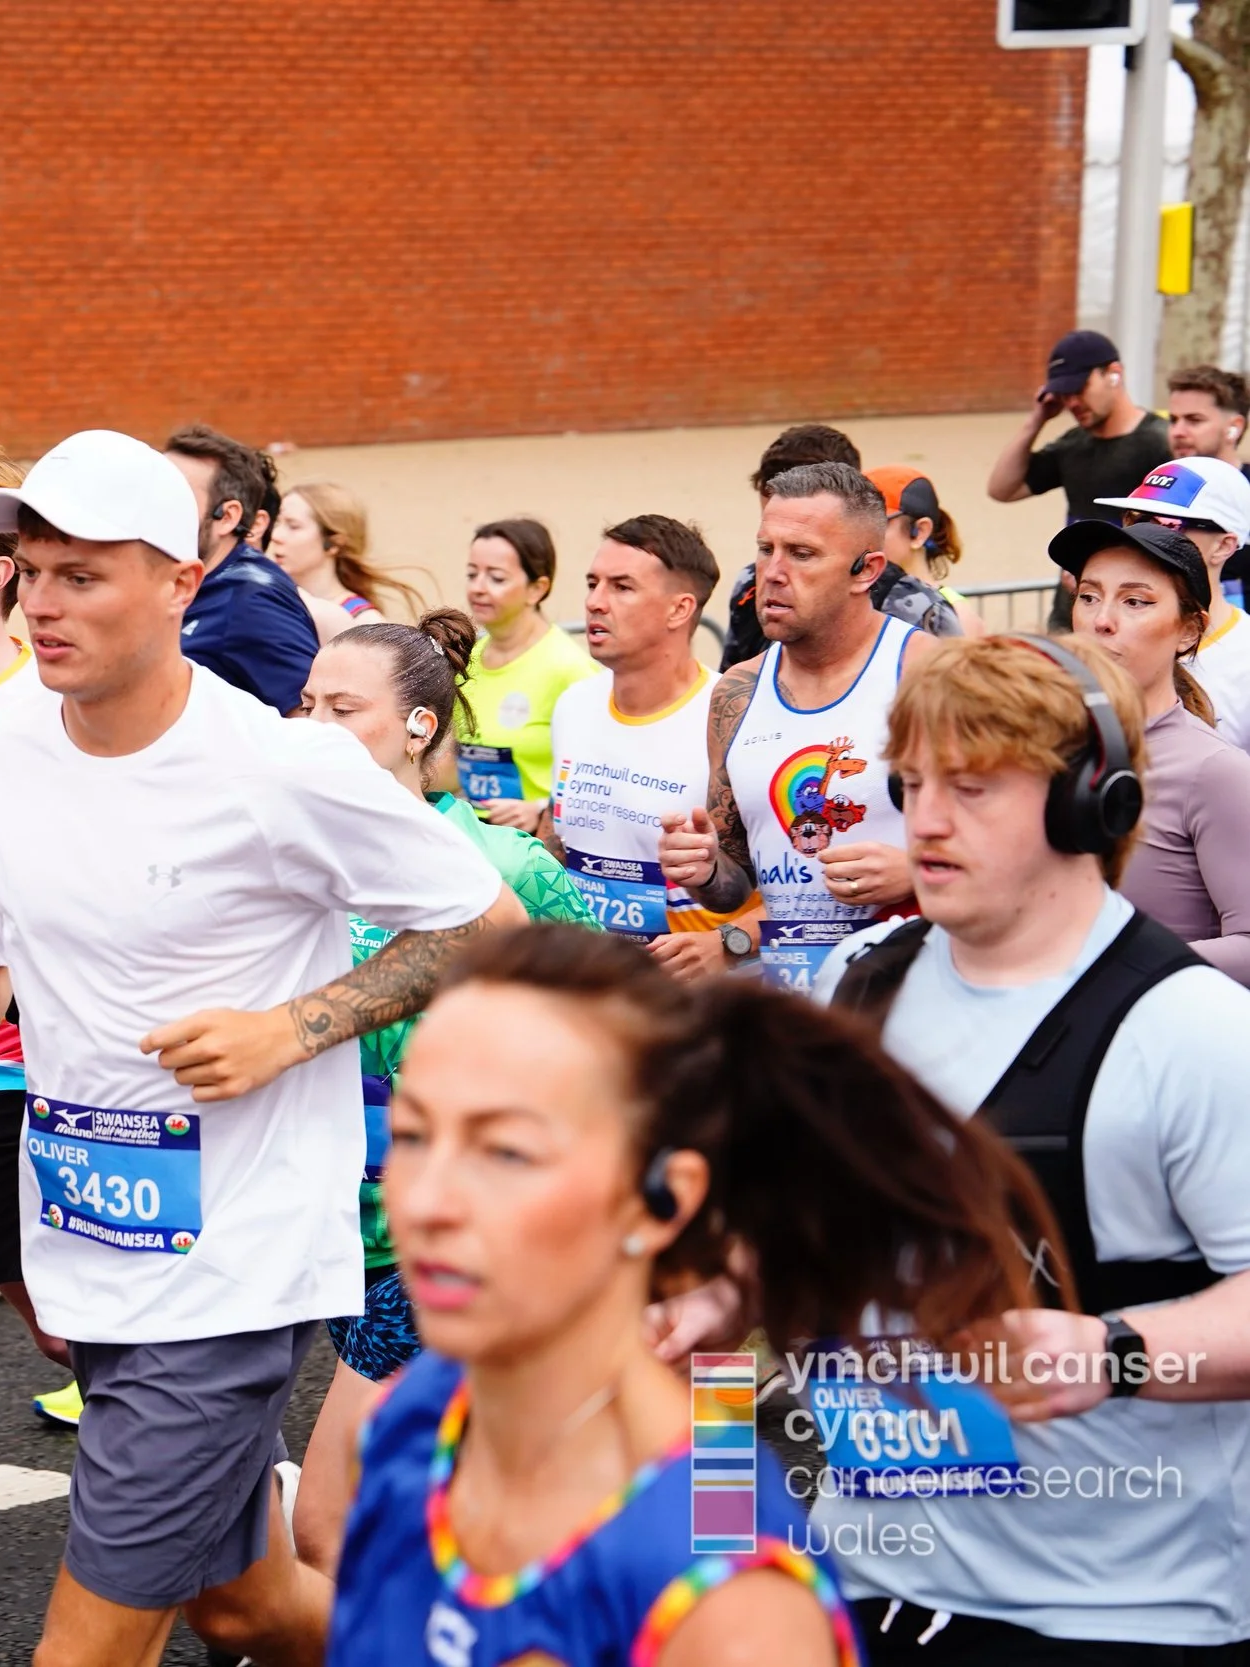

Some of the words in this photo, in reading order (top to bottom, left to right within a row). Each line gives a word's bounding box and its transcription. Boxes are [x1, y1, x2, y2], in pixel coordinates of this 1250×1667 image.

[569, 779, 612, 797] cymru
[574, 761, 630, 782] ymchwil
[631, 773, 687, 795] canser
[566, 815, 605, 832] wales
[612, 804, 662, 828] researc
[95, 1111, 160, 1130] SWANSEA
[95, 1125, 115, 1137] Half
[113, 1127, 161, 1142] Marathon
[28, 1138, 89, 1167] OLIVER
[58, 1166, 161, 1221] 3430
[68, 1215, 165, 1249] #RUNSWANSEA
[814, 1388, 885, 1408] OLIVER
